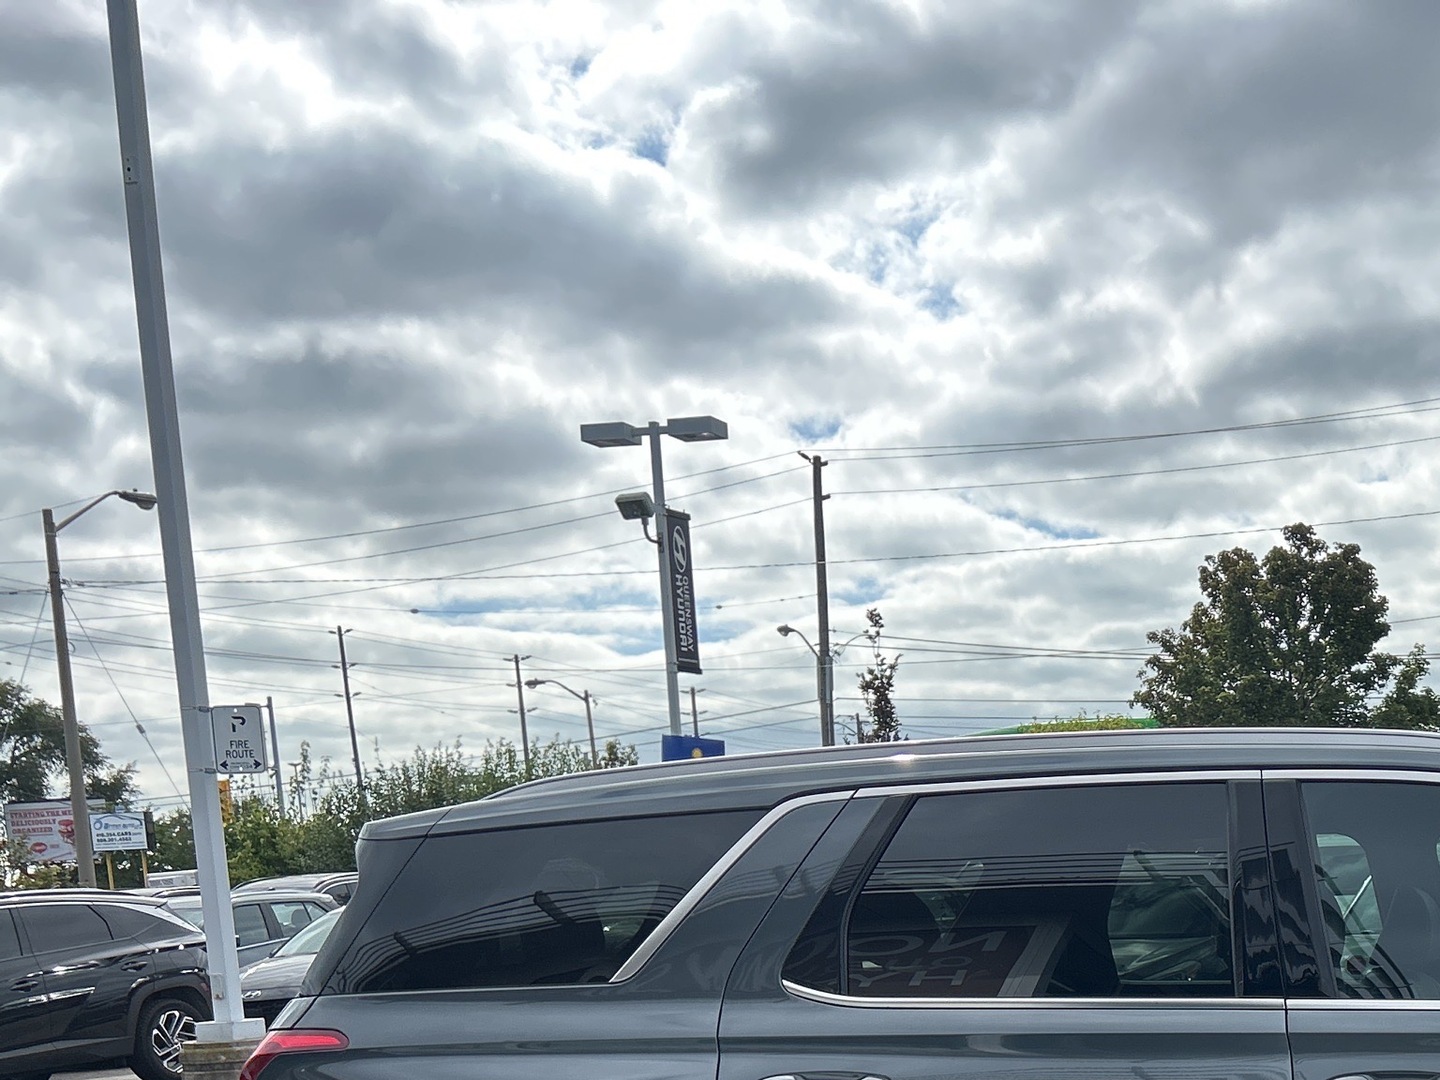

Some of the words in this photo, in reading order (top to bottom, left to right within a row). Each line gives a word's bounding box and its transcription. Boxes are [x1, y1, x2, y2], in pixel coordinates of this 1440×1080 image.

[675, 574, 688, 652] HYUNDAI
[683, 576, 694, 652] QUEENSWAY
[229, 740, 250, 749] FIRE
[225, 749, 256, 759] ROUTE
[10, 810, 45, 819] STARTING
[11, 818, 57, 827] DELICIOUSLY
[12, 826, 53, 835] ORGANIZED
